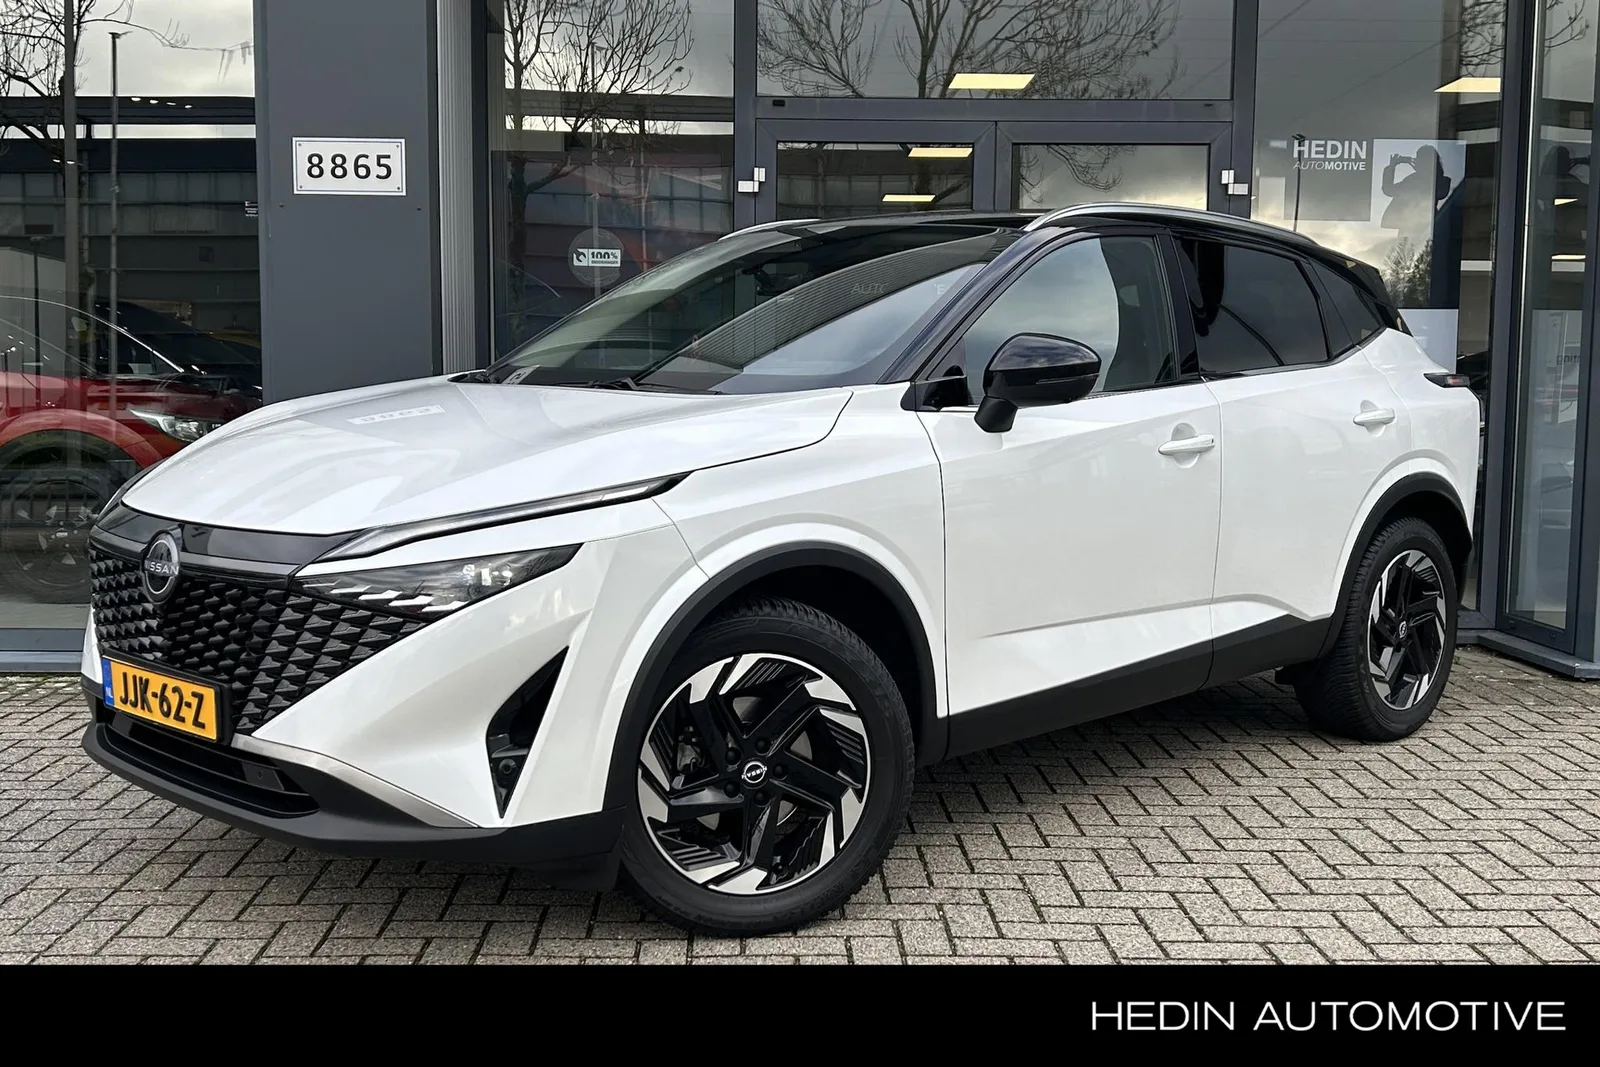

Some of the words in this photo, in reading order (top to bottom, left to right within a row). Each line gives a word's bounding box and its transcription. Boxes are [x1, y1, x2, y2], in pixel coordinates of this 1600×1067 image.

[1292, 138, 1368, 159] HEDIN
[307, 153, 392, 180] 8865
[1292, 160, 1367, 171] AUTOMOTIVE
[591, 251, 619, 260] 100%
[146, 560, 180, 575] SSAN
[119, 671, 207, 730] JJK-62-Z
